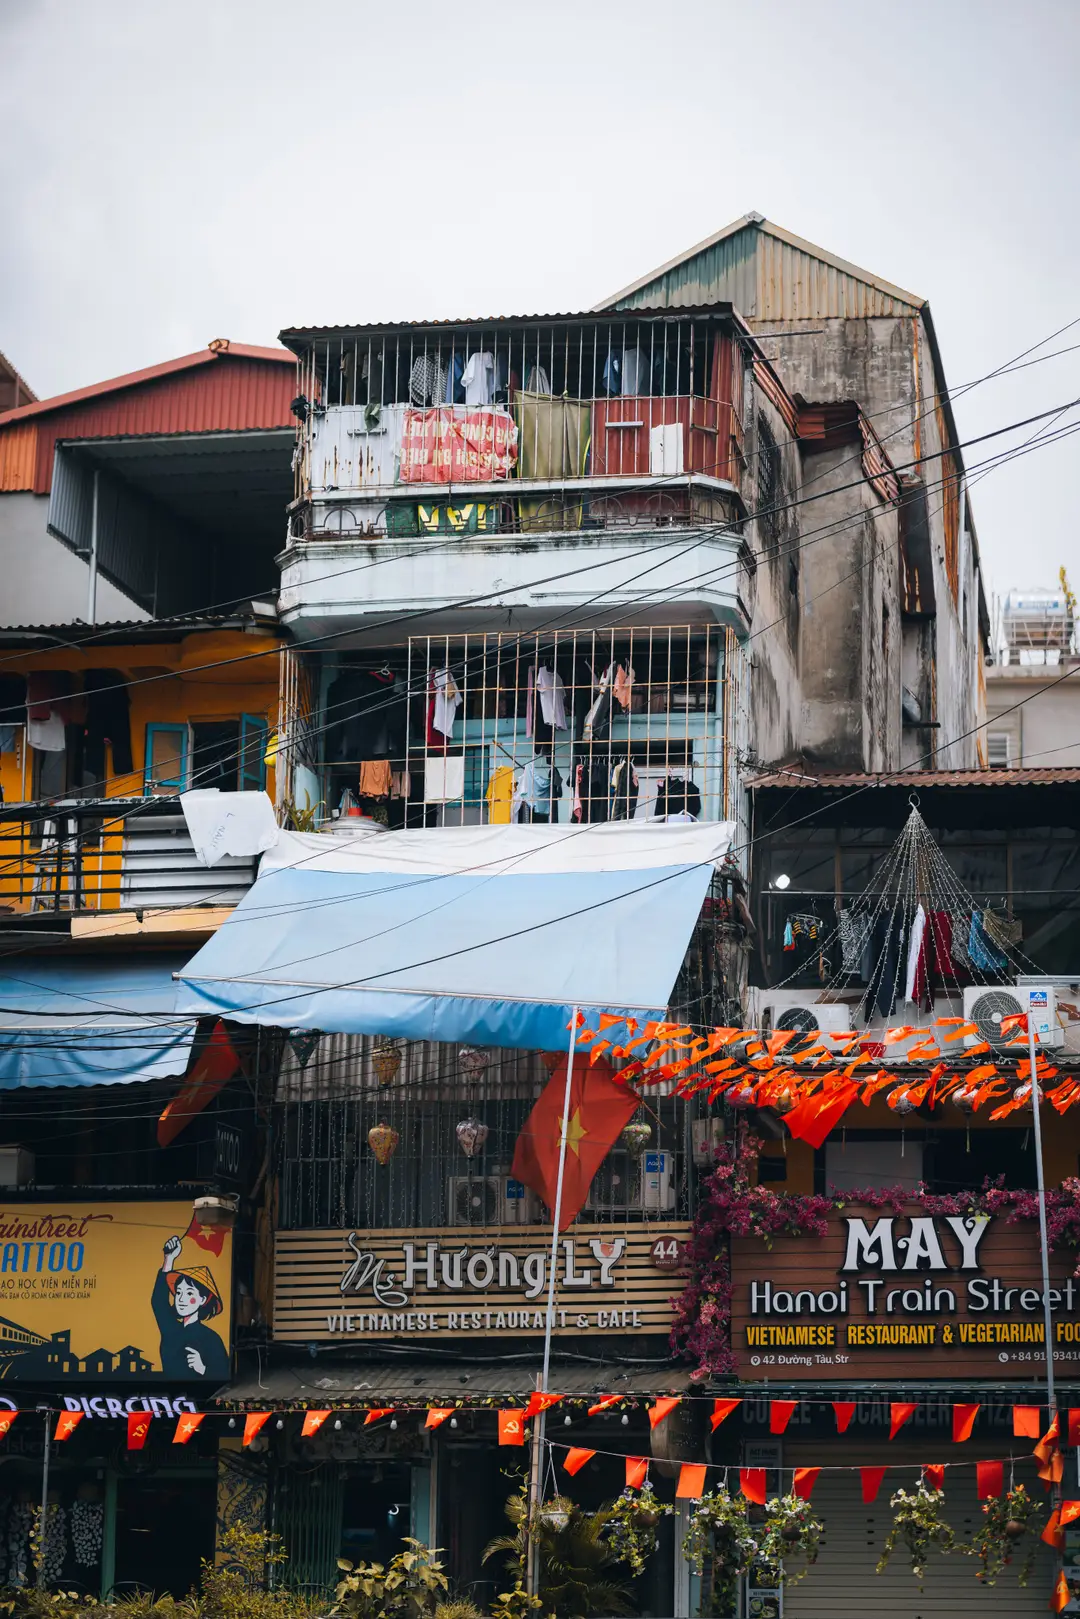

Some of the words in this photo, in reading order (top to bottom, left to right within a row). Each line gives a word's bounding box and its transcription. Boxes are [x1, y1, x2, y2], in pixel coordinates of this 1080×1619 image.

[0, 1213, 114, 1239] ainstreet
[653, 1240, 679, 1259] 44
[841, 1216, 992, 1271] MAY
[0, 1241, 85, 1273] ATTOO
[340, 1231, 410, 1307] Ms
[750, 1280, 848, 1313] Hanoi
[859, 1278, 956, 1312] Train
[967, 1278, 1077, 1311] Street
[327, 1311, 439, 1333] VIETNAMESE
[576, 1313, 590, 1328] &
[597, 1308, 643, 1328] CAFE
[746, 1325, 835, 1346] VIETNAMESE
[847, 1324, 936, 1345] RESTAURANT
[942, 1325, 953, 1343] &
[959, 1322, 1045, 1343] VEGETARIAN
[762, 1355, 775, 1364] 42
[778, 1354, 812, 1366] Đường
[835, 1354, 849, 1364] Str
[1011, 1351, 1031, 1361] +84
[63, 1395, 198, 1419] PIERCING
